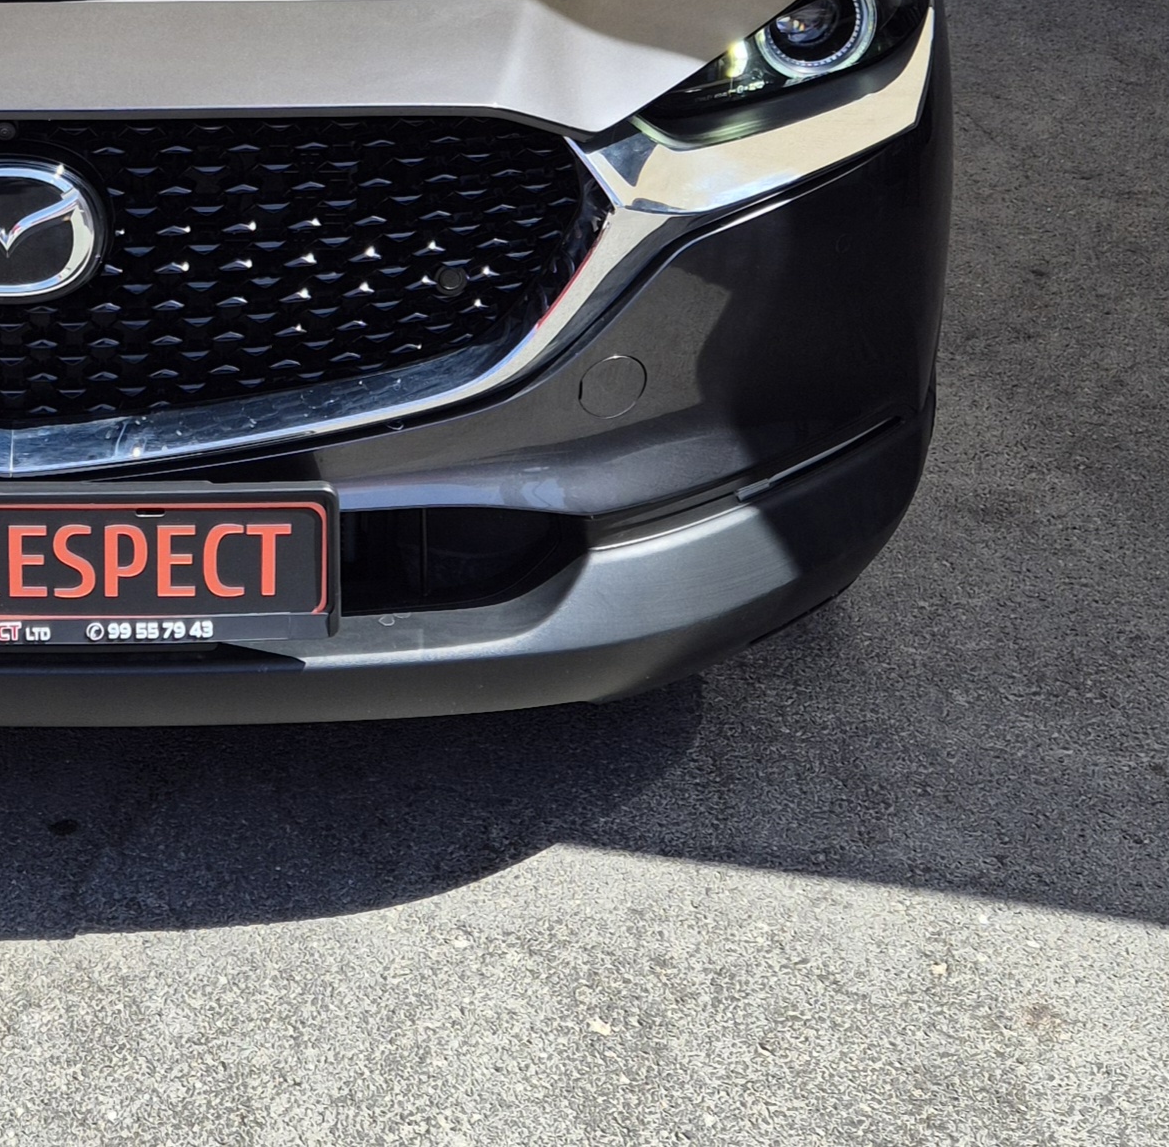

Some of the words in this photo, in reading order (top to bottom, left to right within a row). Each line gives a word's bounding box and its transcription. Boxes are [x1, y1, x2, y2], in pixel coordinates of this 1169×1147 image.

[26, 626, 51, 641] LTD
[107, 622, 132, 640] 99
[135, 622, 159, 639] 55
[162, 621, 186, 639] 79
[189, 621, 214, 639] 43
